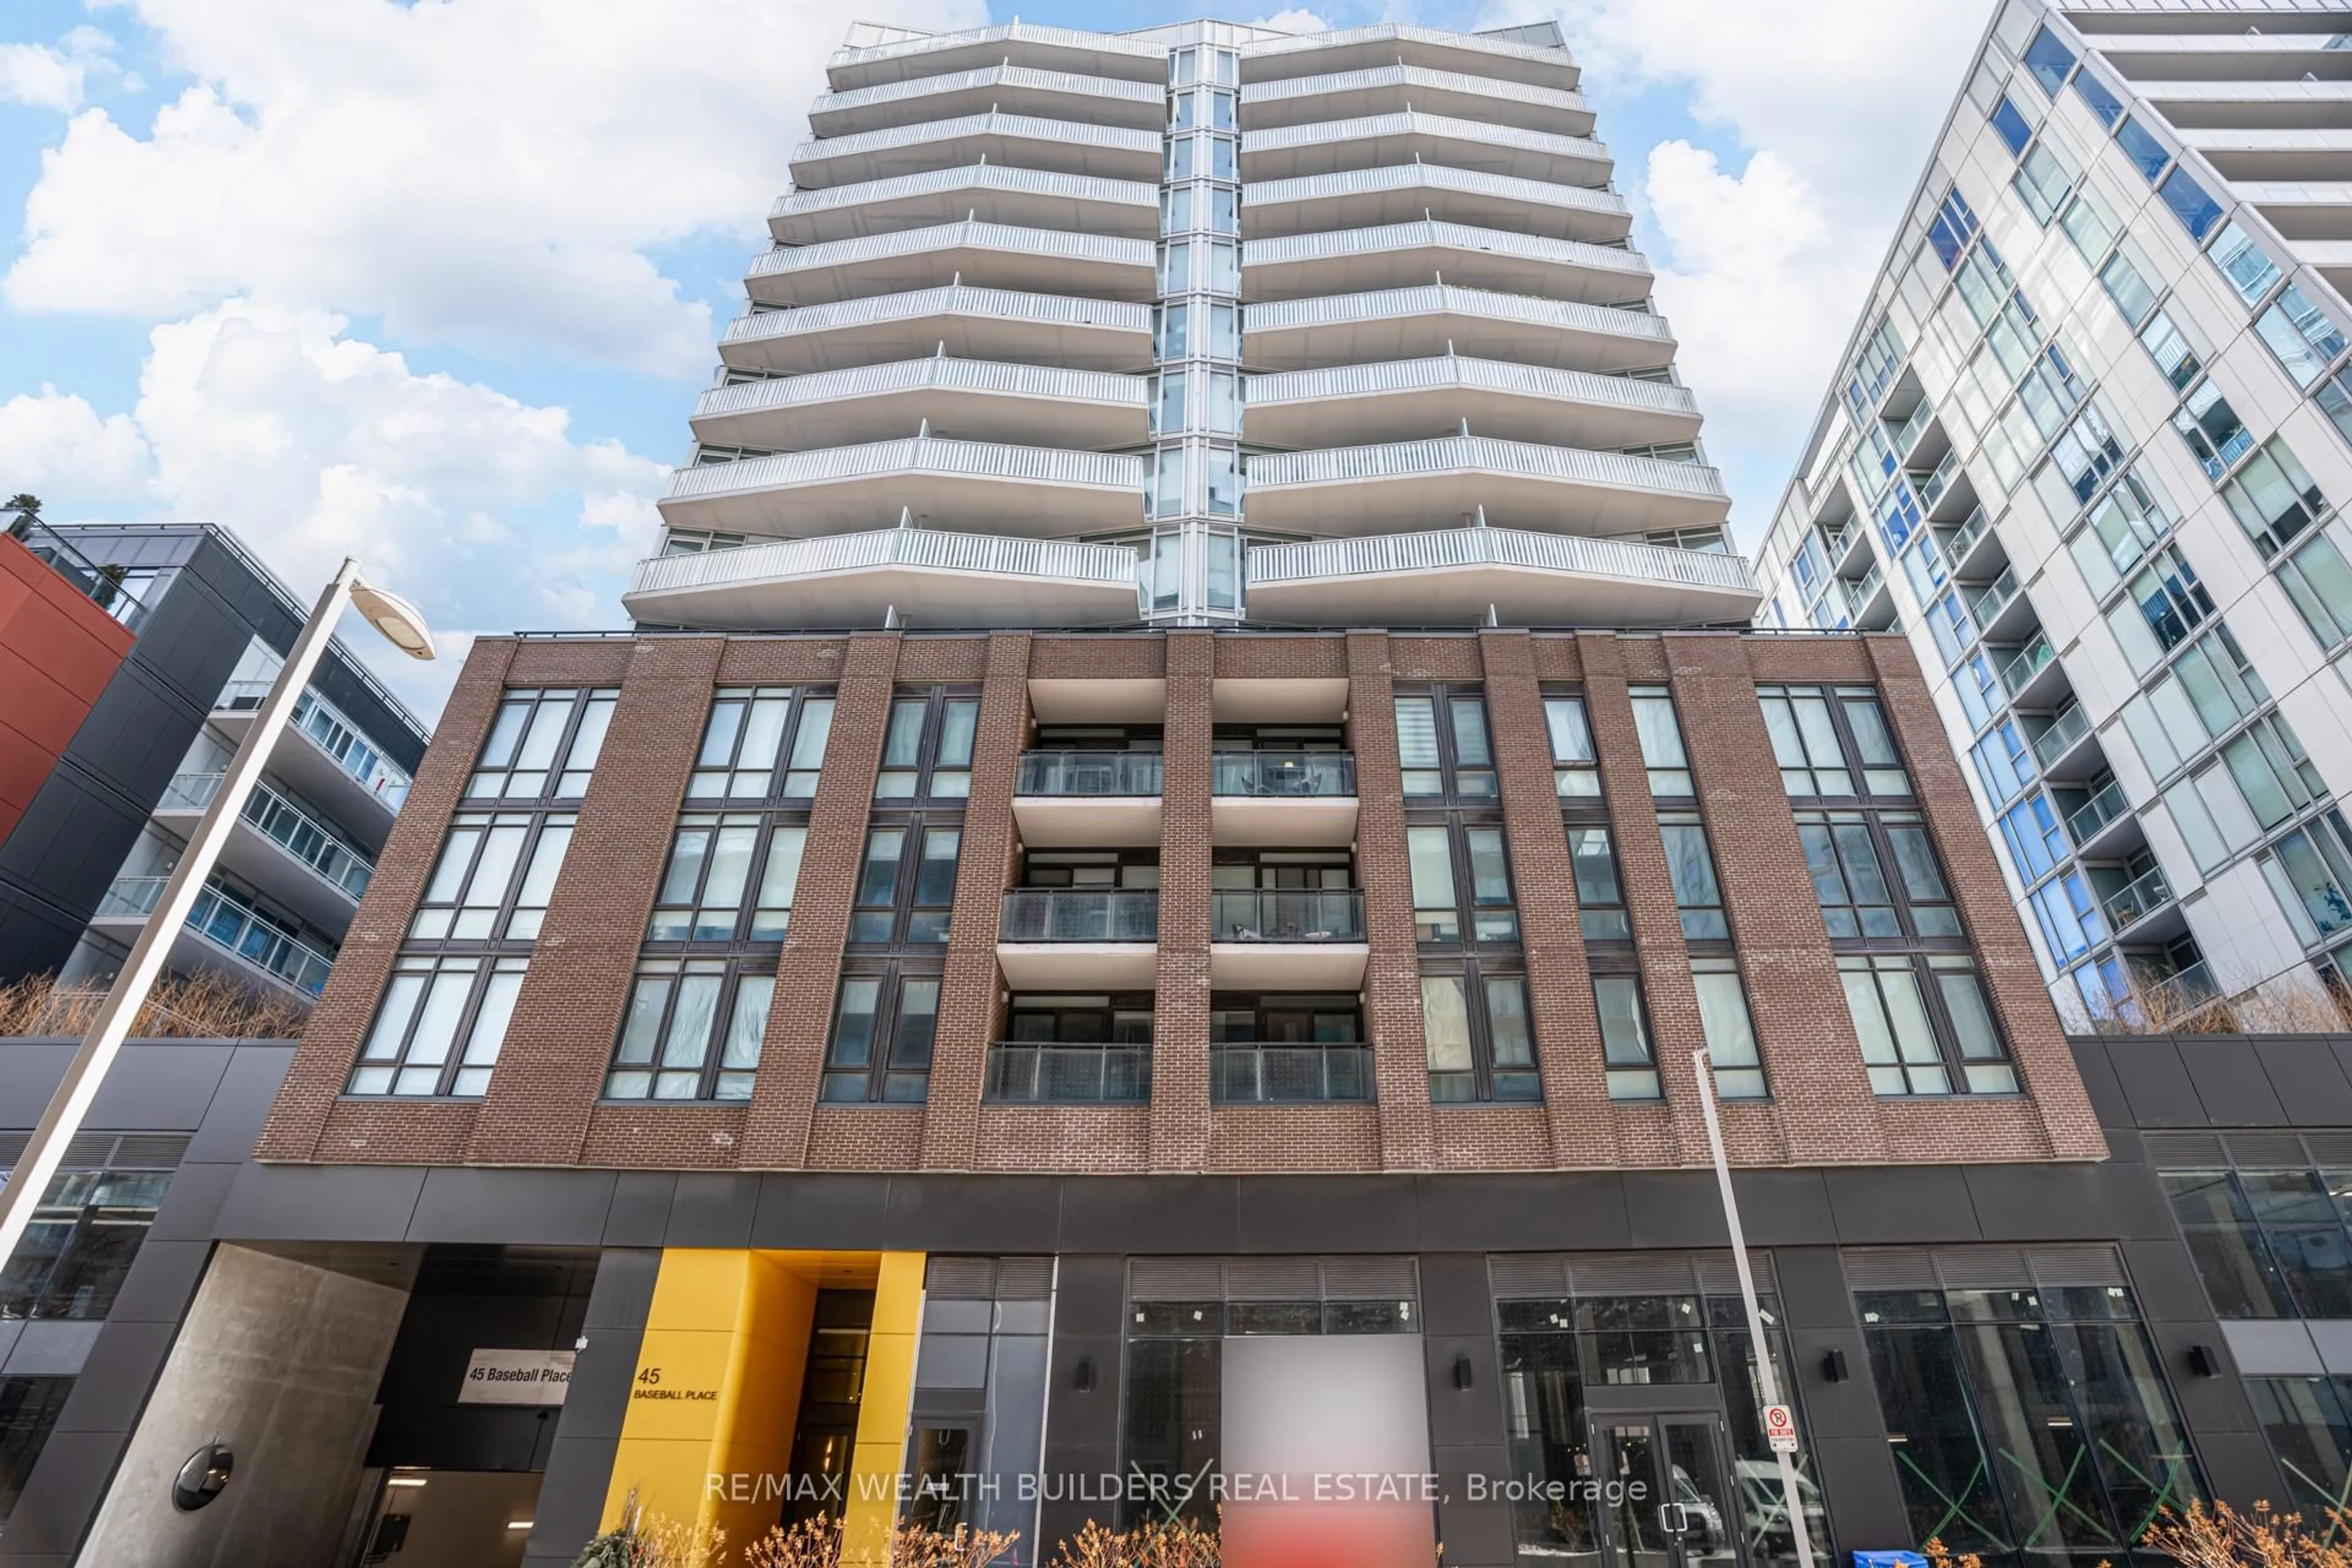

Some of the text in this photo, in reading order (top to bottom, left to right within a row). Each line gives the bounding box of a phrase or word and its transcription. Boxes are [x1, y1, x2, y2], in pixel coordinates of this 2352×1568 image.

[470, 1367, 485, 1381] 45
[487, 1368, 539, 1382] Baseball
[638, 1368, 661, 1384] 45
[634, 1390, 718, 1400] BASEBALL PLACE
